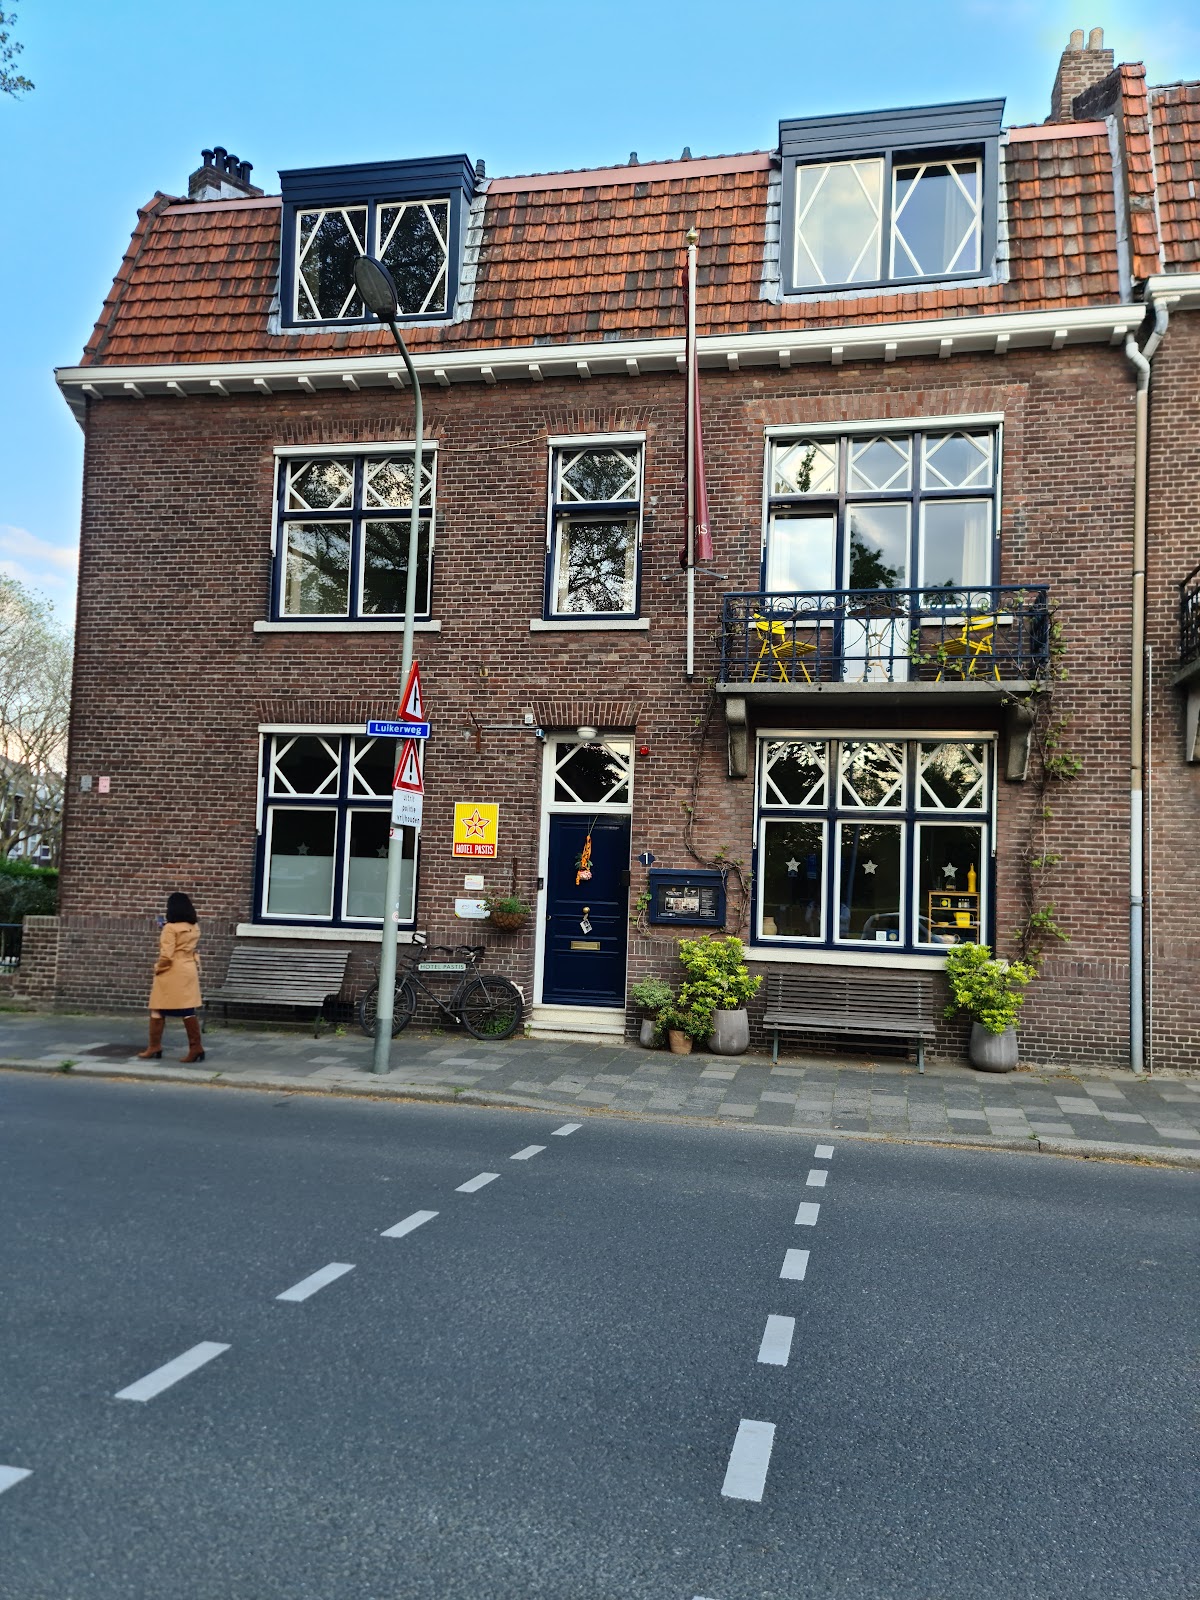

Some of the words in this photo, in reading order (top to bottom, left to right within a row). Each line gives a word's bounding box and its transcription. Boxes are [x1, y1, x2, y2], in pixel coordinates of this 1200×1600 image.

[375, 723, 422, 735] Luikerweg
[397, 814, 420, 823] vrijhouden
[456, 844, 473, 854] HOTEL
[474, 844, 494, 855] PASTIS
[643, 852, 648, 864] 1
